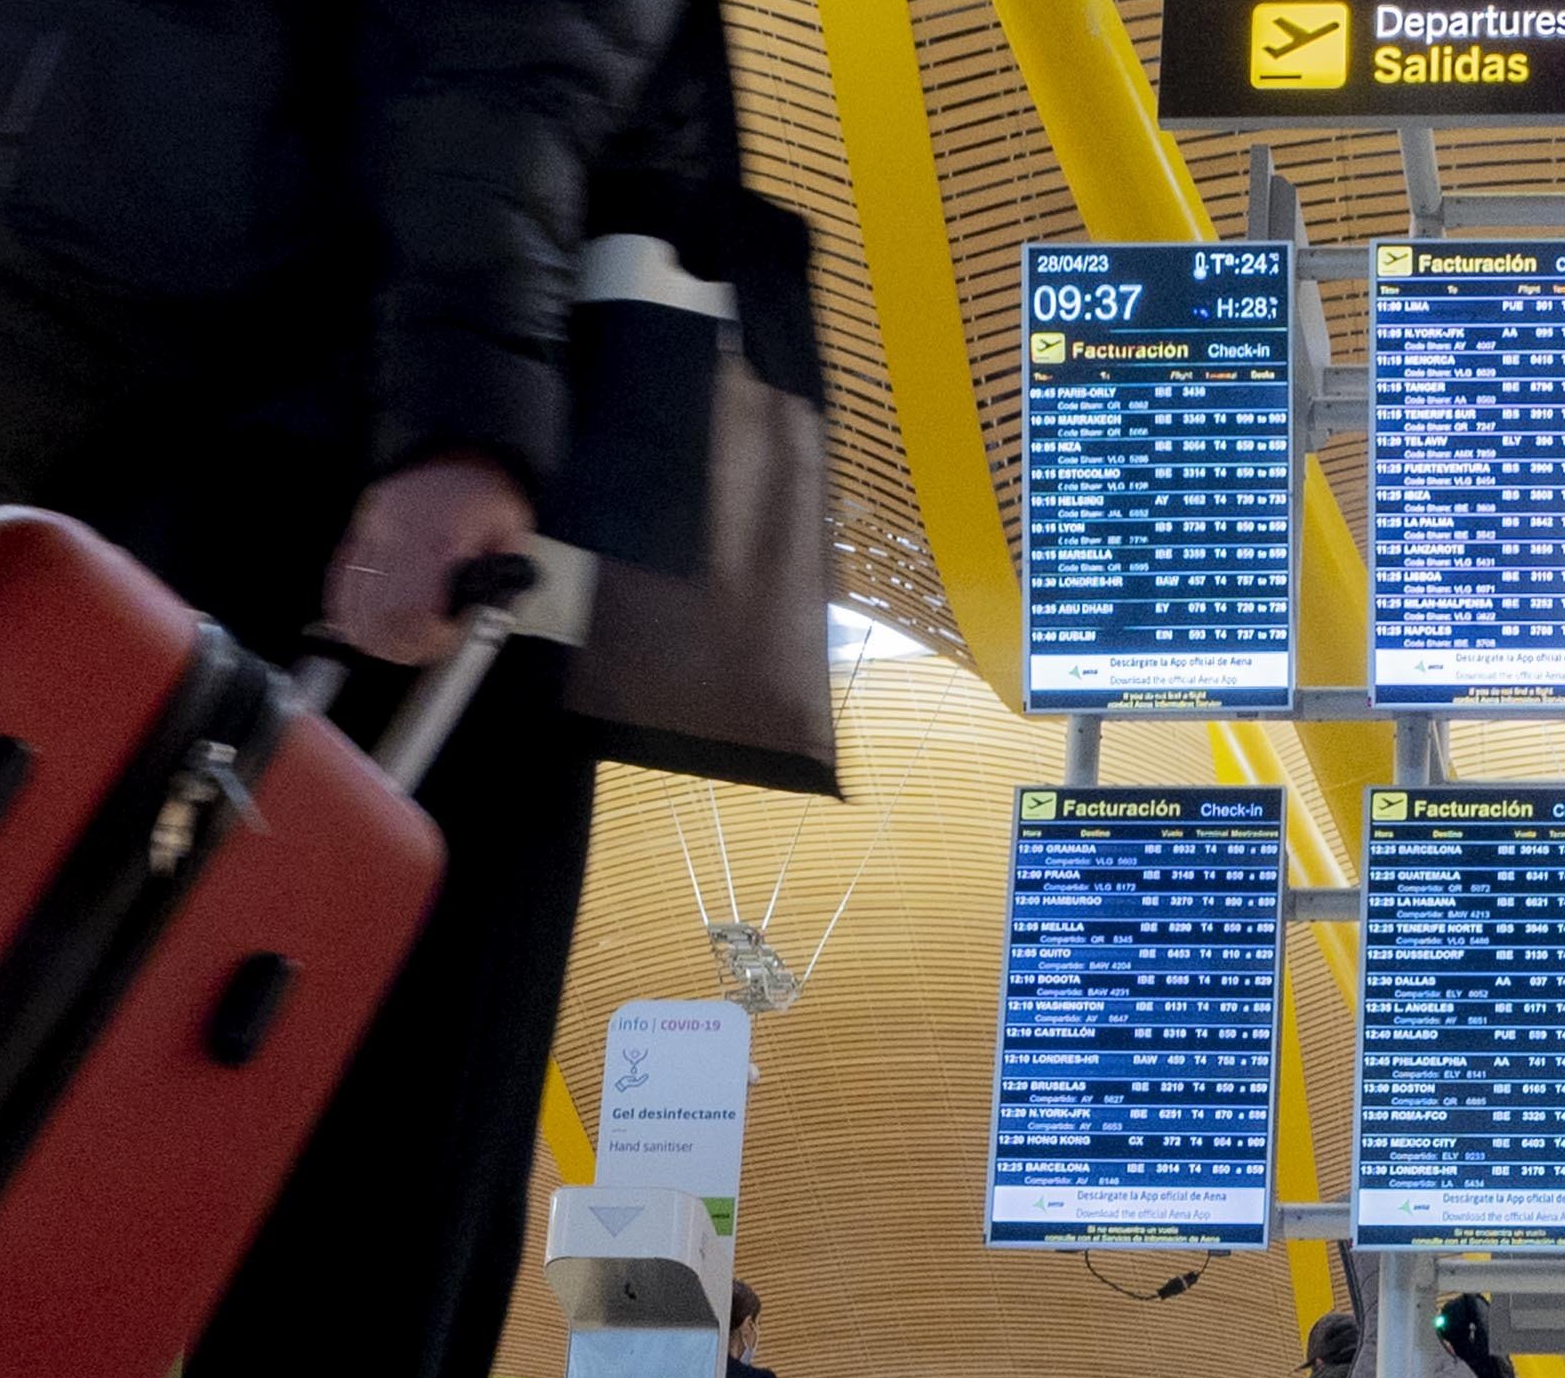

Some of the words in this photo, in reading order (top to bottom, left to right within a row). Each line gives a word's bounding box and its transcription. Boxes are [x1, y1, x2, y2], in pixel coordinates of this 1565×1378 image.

[1374, 45, 1529, 84] Salidas
[1037, 256, 1109, 272] 28/04/23
[1419, 253, 1537, 273] Facturación
[1034, 284, 1142, 320] 09:37
[1072, 342, 1188, 358] Facturación
[1208, 343, 1270, 357] Check-in
[1063, 800, 1180, 816] Facturación
[1201, 803, 1263, 817] Check-in
[1414, 799, 1533, 818] Facturación
[1398, 846, 1462, 854] BARCELONA
[619, 1017, 649, 1031] info
[660, 1020, 721, 1031] COVID-19
[1392, 1084, 1435, 1093] BOSTON
[612, 1108, 634, 1120] Gel
[638, 1108, 736, 1120] desinfectante
[609, 1140, 640, 1152] Hand
[643, 1140, 693, 1152] sanitiser
[1026, 1163, 1089, 1172] BARCELONA
[1444, 1194, 1494, 1205] Descárgate
[1507, 1194, 1524, 1205] App
[1527, 1194, 1554, 1203] oficial
[1443, 1212, 1485, 1222] Download
[1488, 1212, 1502, 1222] the
[1536, 1212, 1558, 1222] Aena
